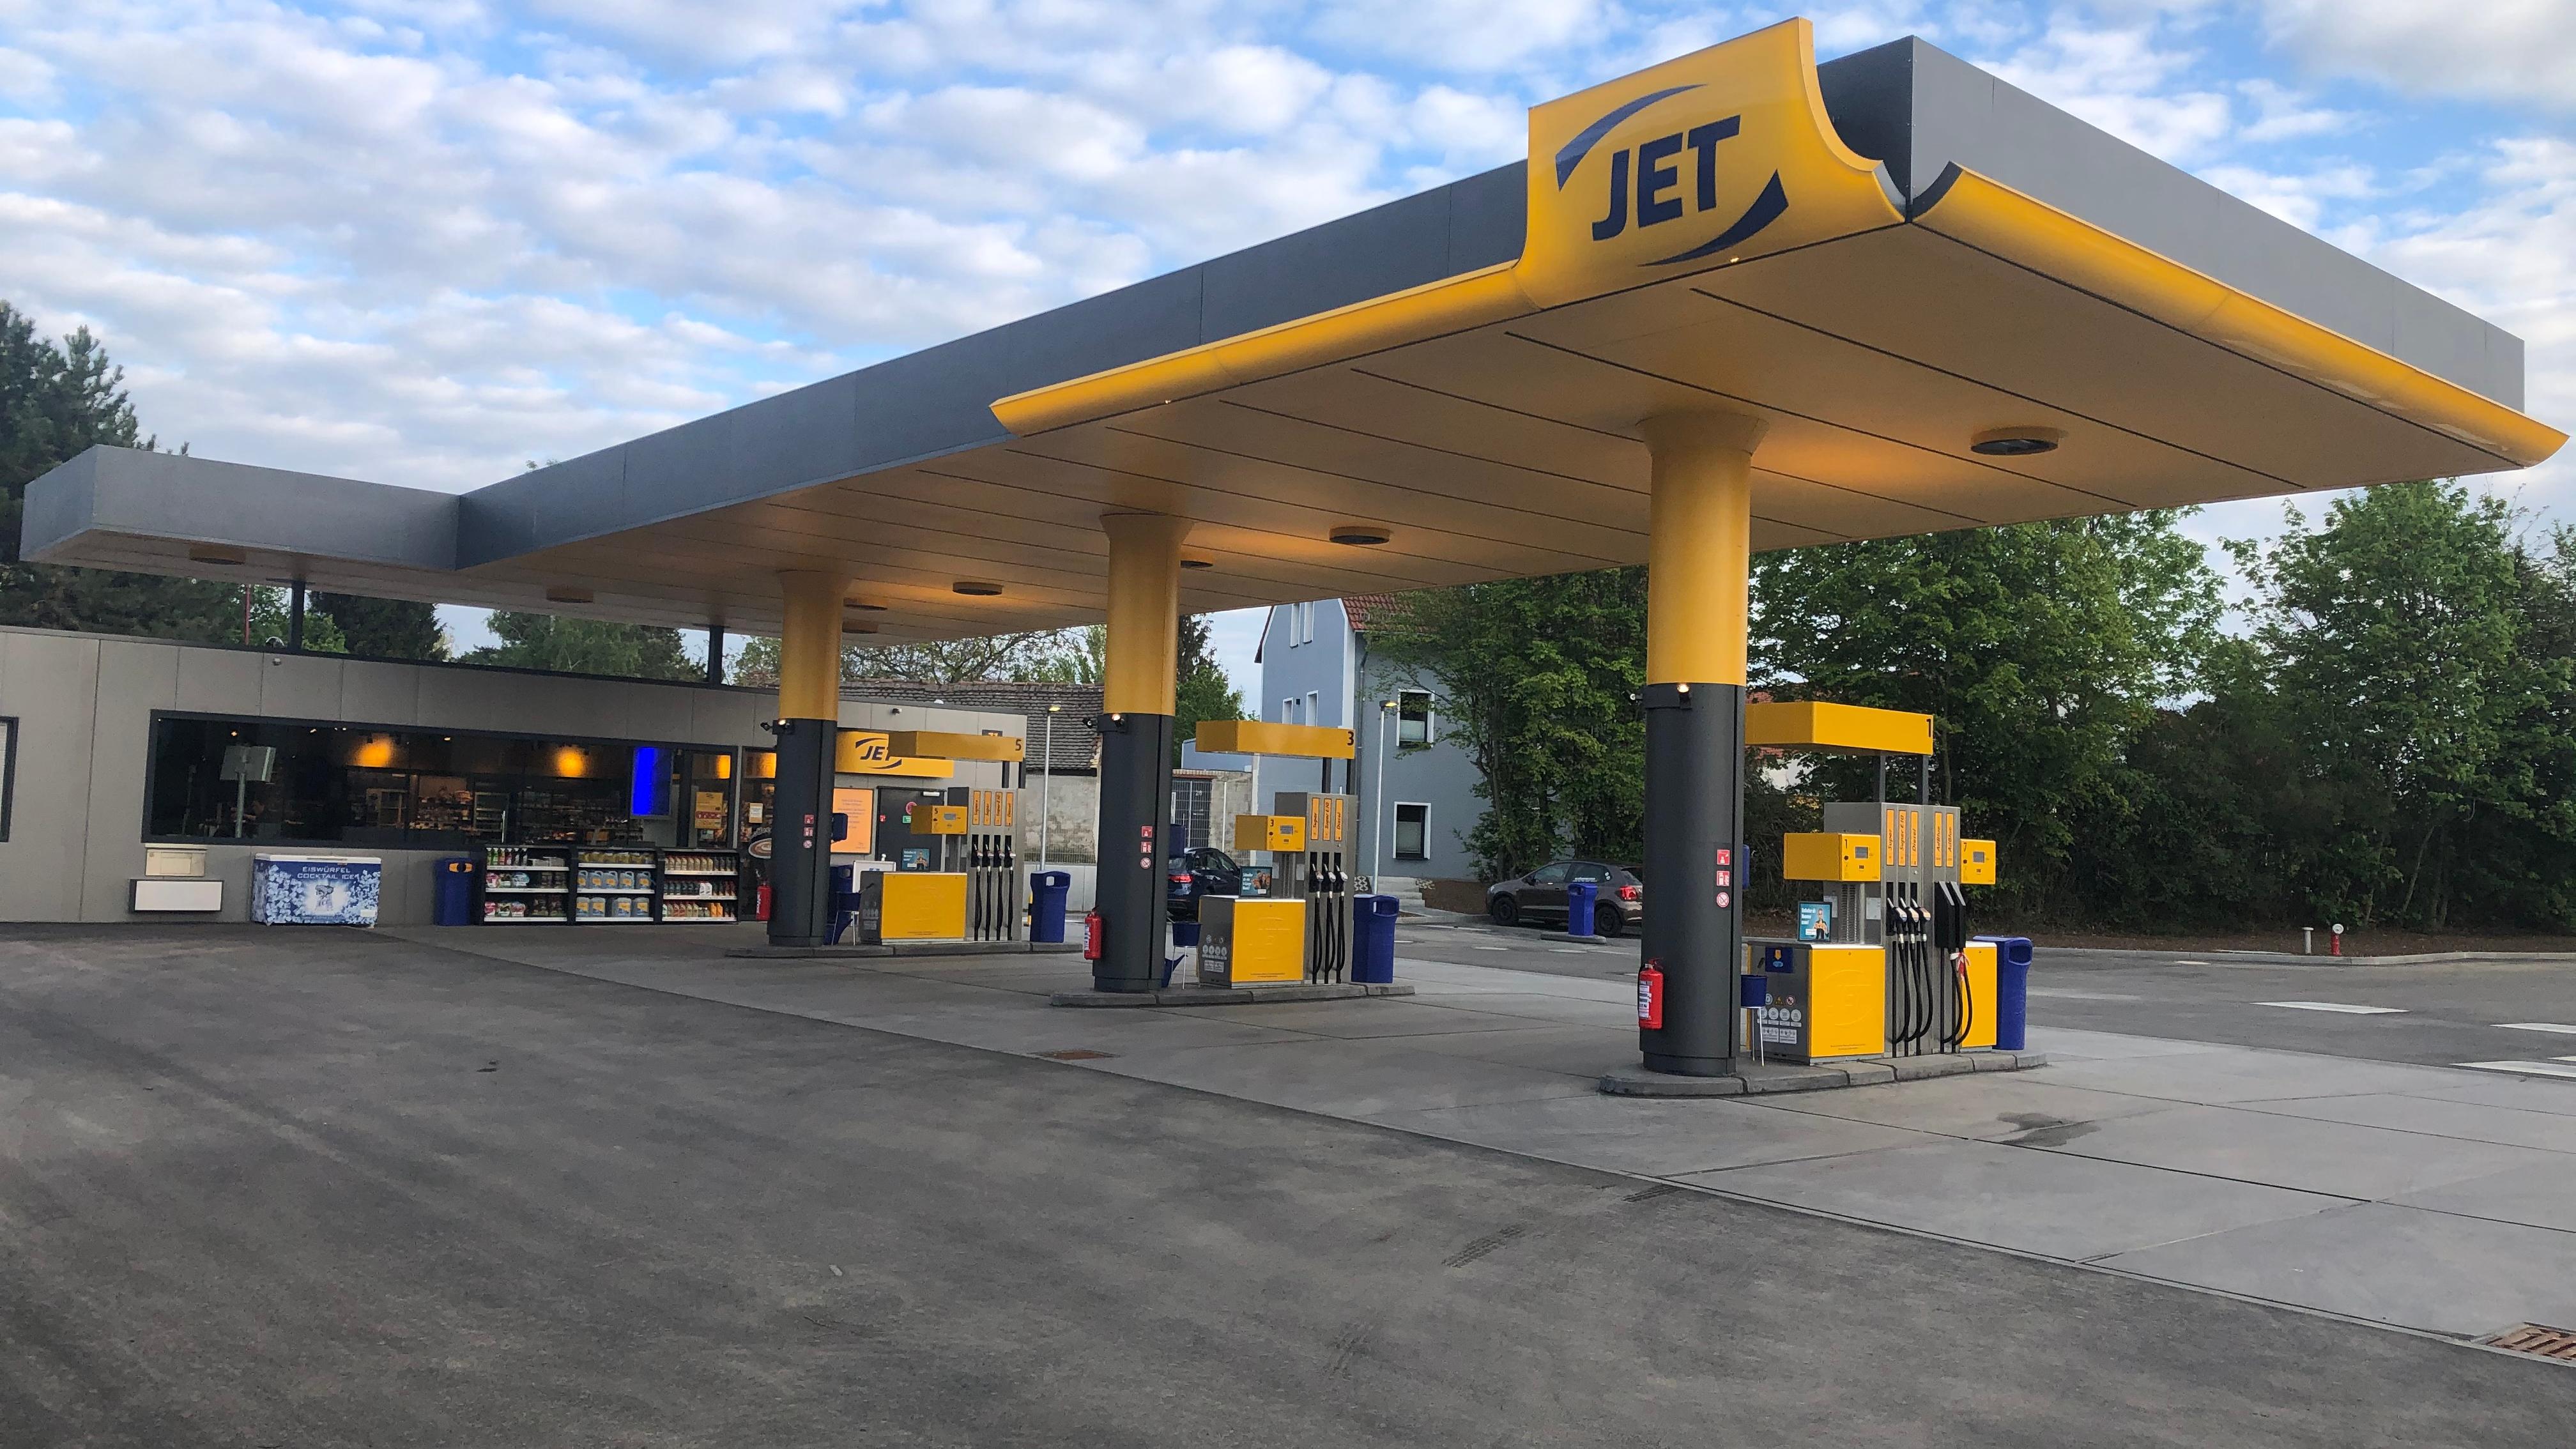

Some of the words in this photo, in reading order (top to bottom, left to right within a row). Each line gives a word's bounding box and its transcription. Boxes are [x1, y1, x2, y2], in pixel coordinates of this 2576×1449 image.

[1592, 115, 1740, 241] JET
[1926, 719, 1931, 737] 1
[1015, 739, 1022, 751] 5
[1347, 731, 1354, 746] 3
[1844, 839, 1848, 849] 1
